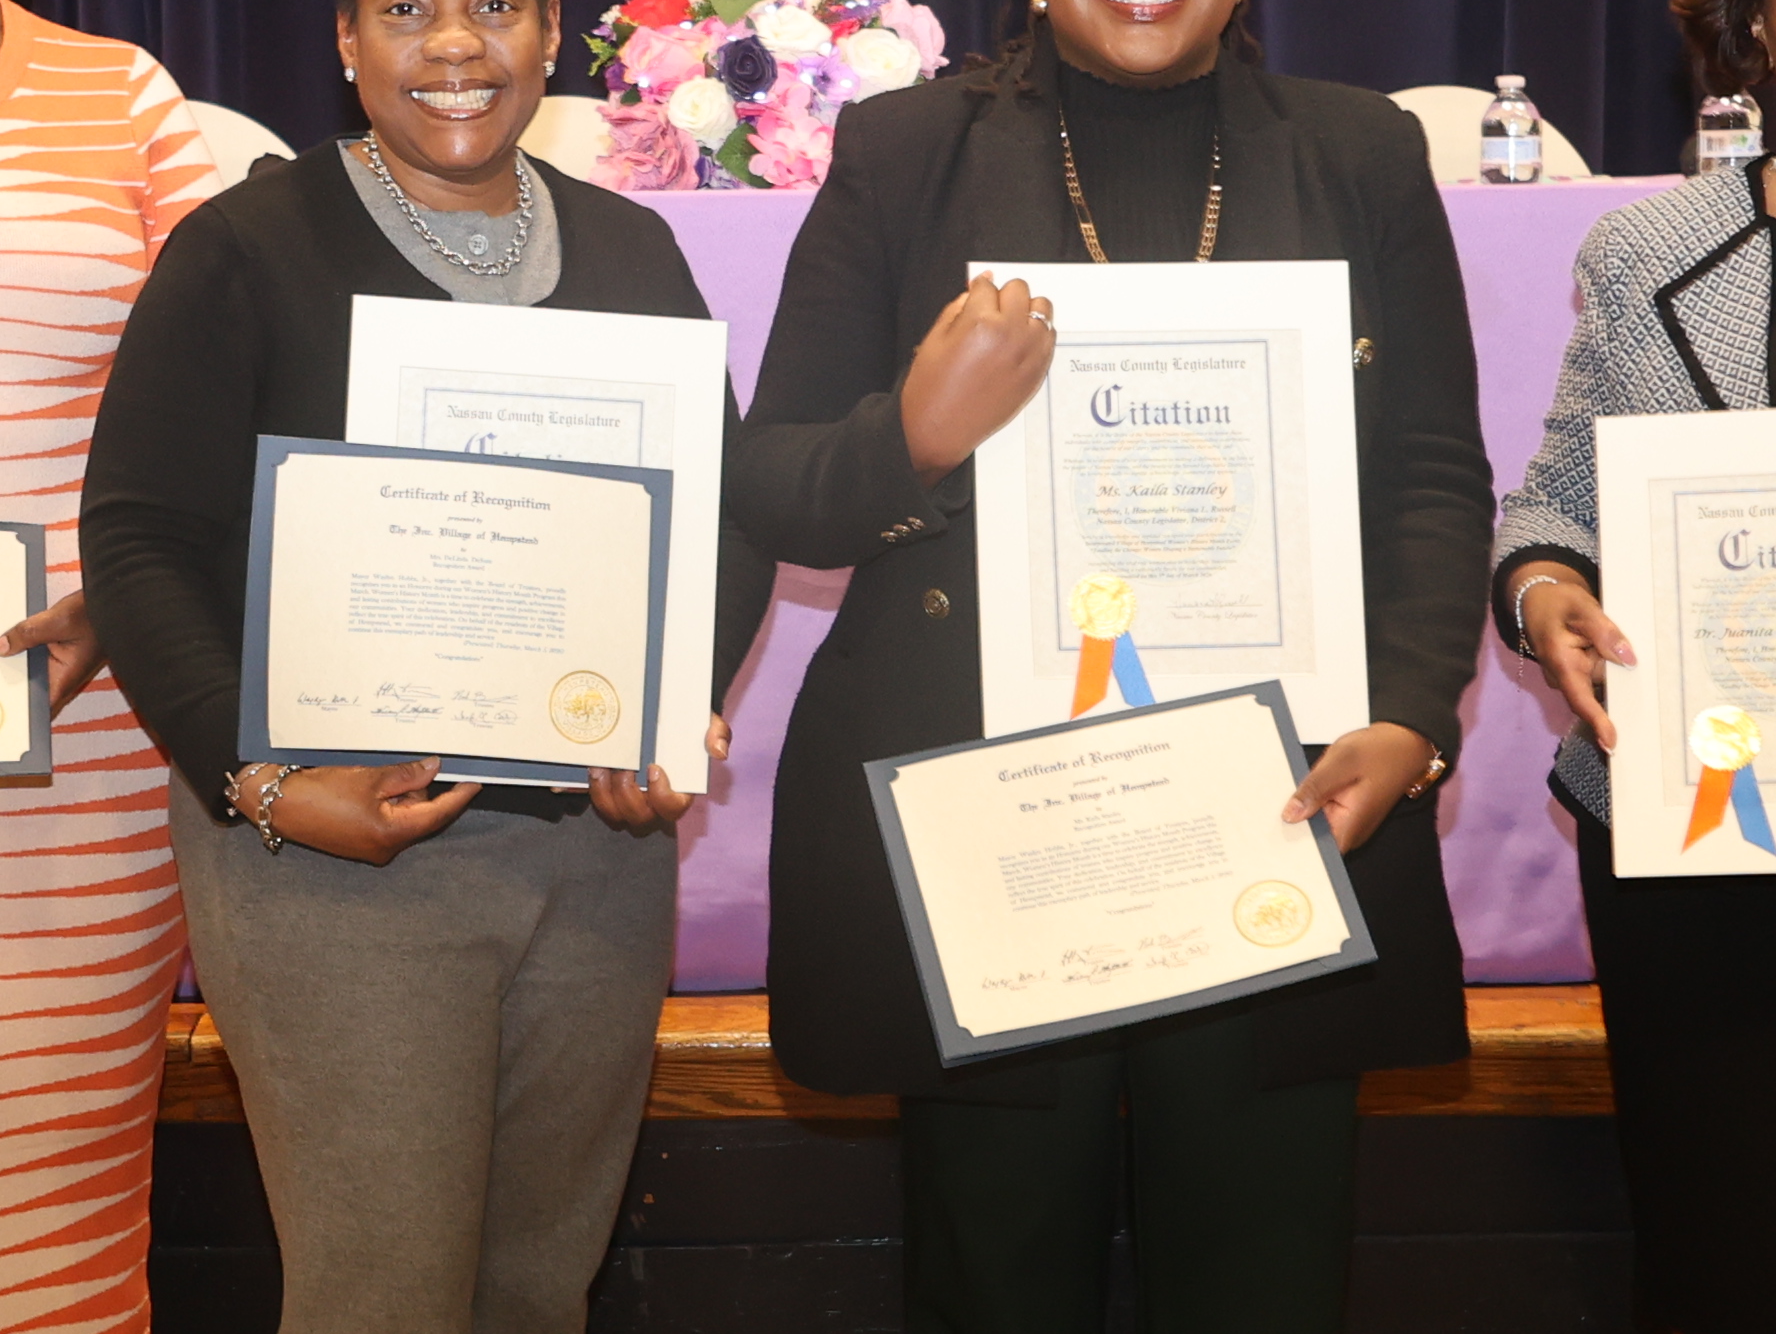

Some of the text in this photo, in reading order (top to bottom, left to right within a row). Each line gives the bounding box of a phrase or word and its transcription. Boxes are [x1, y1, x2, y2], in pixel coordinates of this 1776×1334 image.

[1070, 357, 1246, 373] Nassau County Legislature
[1090, 384, 1231, 427] Citation
[447, 405, 621, 428] Nassau County Legislature
[380, 485, 552, 511] Certificate of Recognition
[1096, 482, 1228, 499] Ms. Kaila Stanley
[1698, 506, 1744, 520] Nassau
[1694, 628, 1716, 640] Dr.
[1718, 624, 1773, 641] Juanita
[998, 760, 1068, 783] Certificate
[1073, 755, 1085, 769] of
[1089, 741, 1171, 768] Recognition
